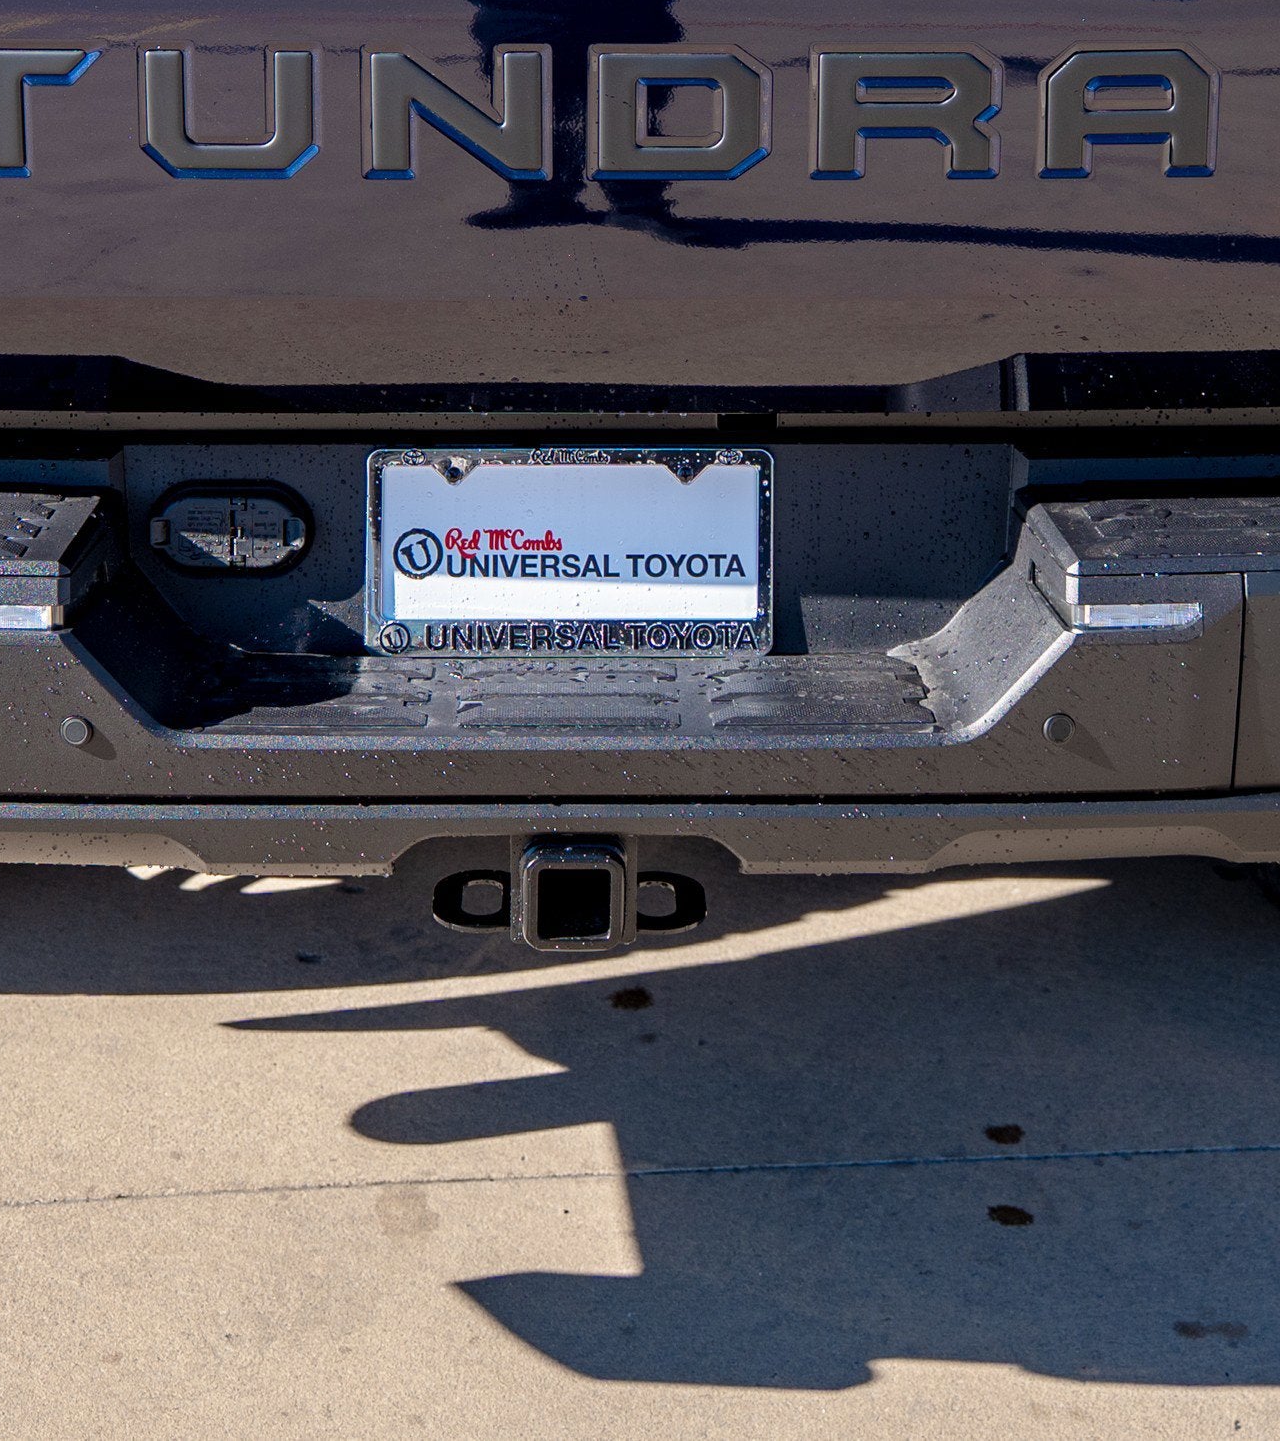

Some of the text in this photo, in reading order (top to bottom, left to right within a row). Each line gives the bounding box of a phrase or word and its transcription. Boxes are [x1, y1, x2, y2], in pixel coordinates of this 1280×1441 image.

[528, 448, 556, 465] Red
[444, 527, 562, 559] Red McCombs
[446, 554, 620, 578] UNIVERSAL
[625, 553, 746, 578] TOYOTA
[424, 622, 620, 651] UNIVERSAL
[625, 621, 759, 651] TOYOTA
